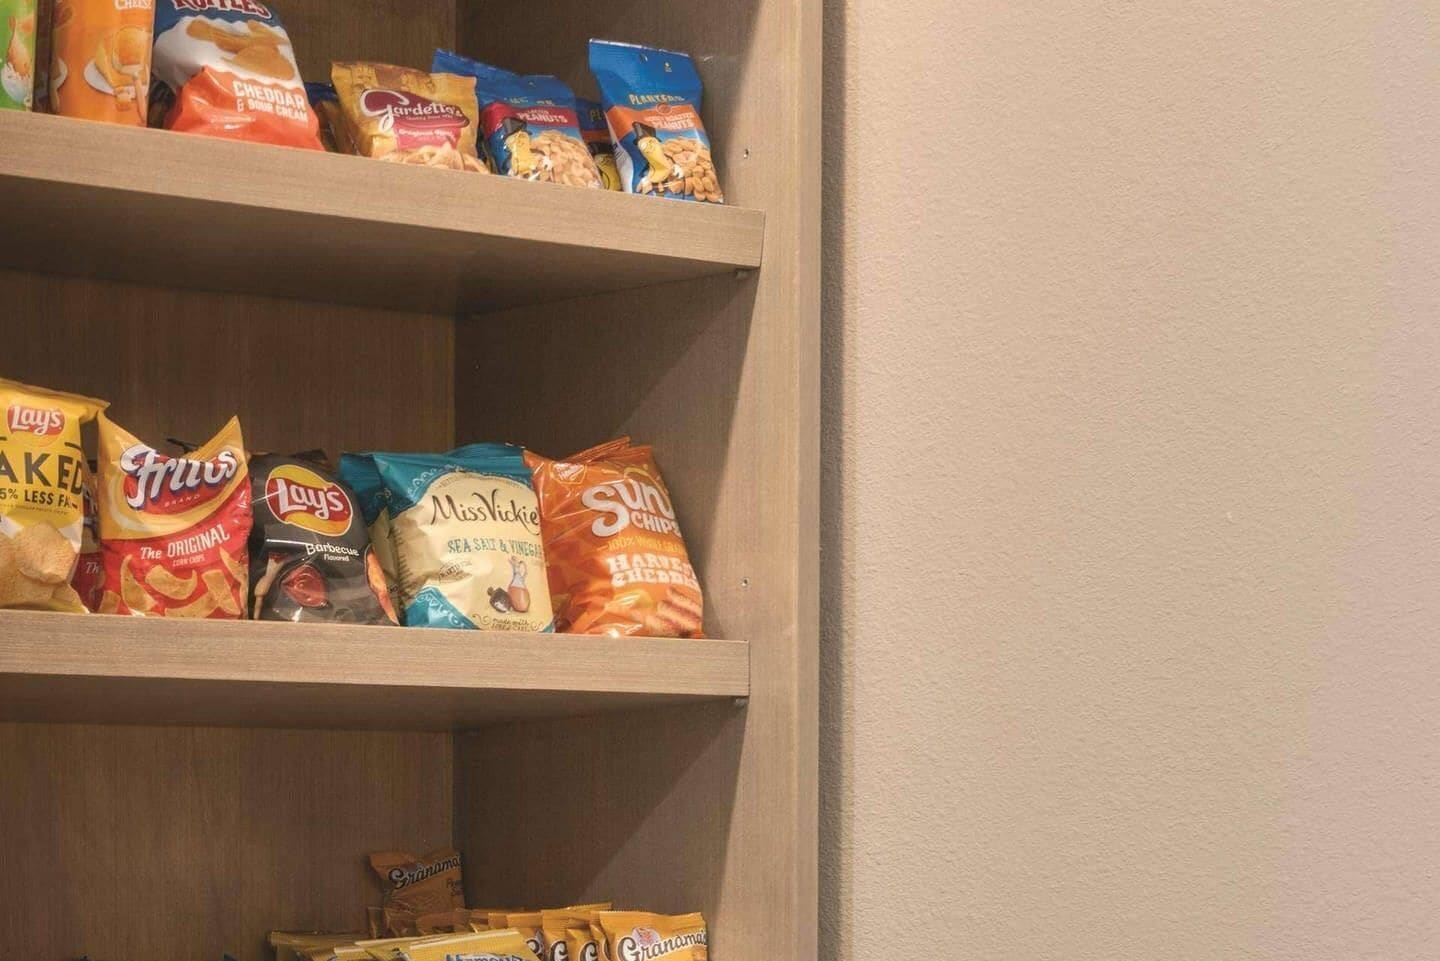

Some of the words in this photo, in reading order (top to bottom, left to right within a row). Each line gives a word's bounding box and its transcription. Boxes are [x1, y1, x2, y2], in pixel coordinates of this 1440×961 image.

[233, 81, 306, 111] CHEDDAR
[248, 98, 274, 112] SOUR
[276, 105, 308, 123] CREAM
[360, 88, 463, 132] Gardetto's
[516, 111, 568, 124] PEANUTS
[10, 404, 62, 436] Lay's
[120, 444, 238, 509] Fritos
[24, 489, 54, 505] LESS
[58, 494, 72, 508] FA
[276, 478, 344, 520] Lay's
[430, 494, 487, 526] Miss
[471, 488, 541, 536] Vickie
[582, 478, 676, 537] Sun
[630, 511, 682, 538] CHIPS
[141, 547, 162, 560] The
[167, 524, 231, 558] ORIGINAL
[304, 542, 360, 557] Barbecue
[447, 538, 472, 554] SEA
[474, 538, 497, 552] SALT
[499, 540, 509, 553] &
[511, 545, 541, 558] VINEGA
[172, 559, 188, 567] CORN
[190, 556, 206, 566] CHIPS
[323, 553, 350, 562] Flavored
[388, 855, 462, 890] Grandma
